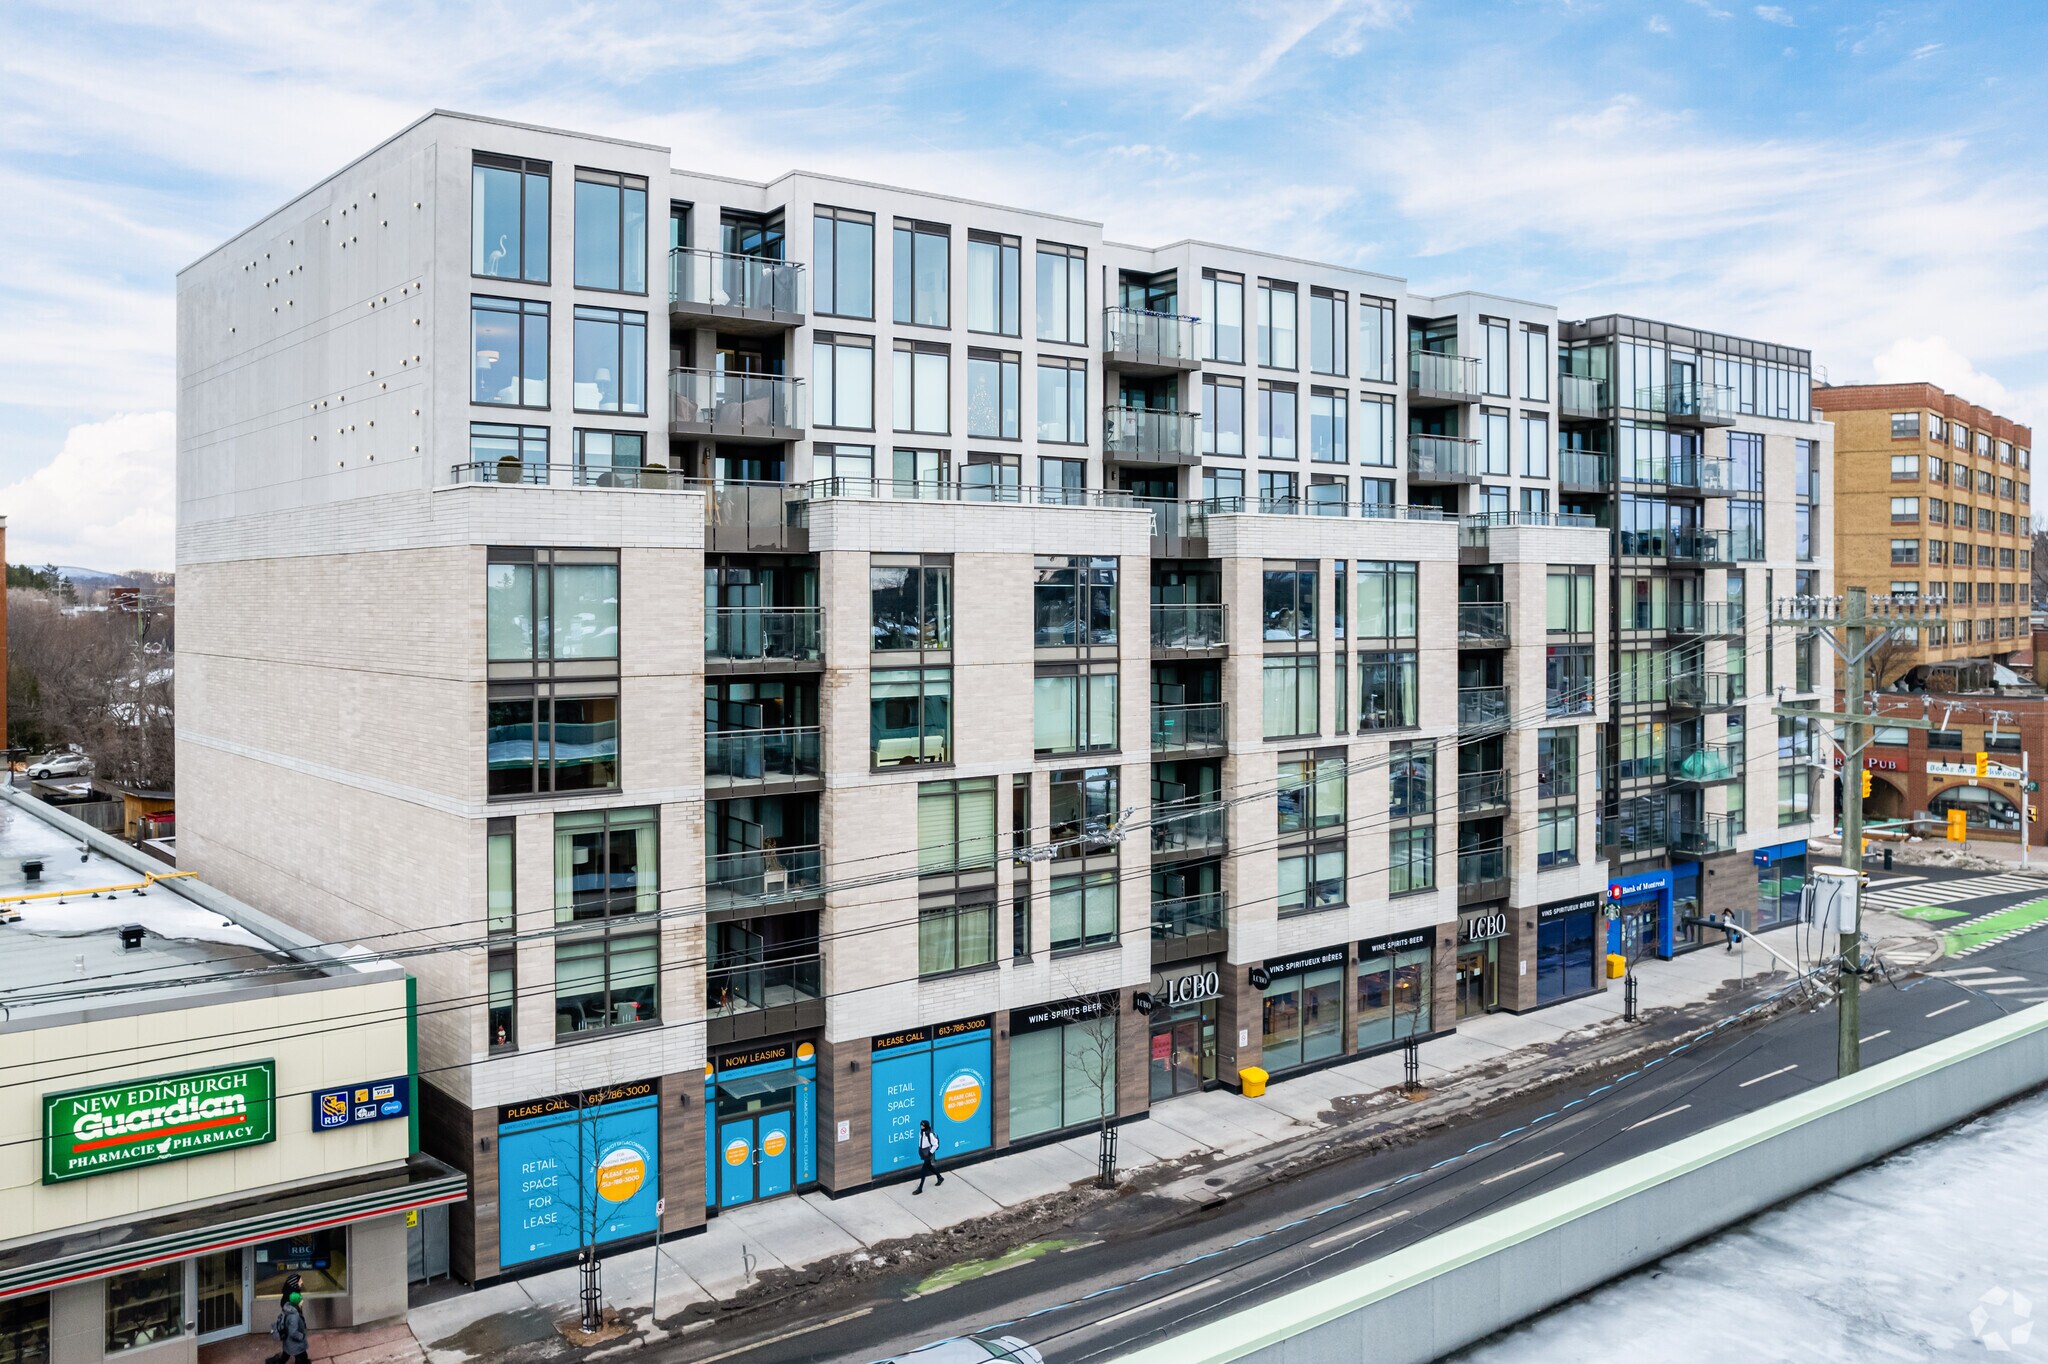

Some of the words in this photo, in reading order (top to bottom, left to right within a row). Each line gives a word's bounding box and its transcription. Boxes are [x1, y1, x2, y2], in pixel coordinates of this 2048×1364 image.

[1868, 758, 1896, 769] PUB
[1622, 885, 1636, 894] Bank
[1636, 883, 1643, 891] of
[1642, 878, 1665, 890] Montreal
[1469, 913, 1506, 940] LCBO
[1252, 974, 1268, 984] LCBO
[1168, 971, 1219, 1004] LCBO
[1136, 998, 1151, 1009] LCBO
[877, 1035, 904, 1048] PLEASE
[905, 1031, 925, 1042] CALL
[938, 1019, 986, 1036] 613-786-3000
[725, 1055, 748, 1067] NOW
[749, 1047, 786, 1063] LEASING
[72, 1093, 121, 1116] NEW
[127, 1073, 247, 1106] EDINBURGH
[887, 1082, 915, 1096] RETAIL
[508, 1104, 543, 1119] PLEASE
[545, 1099, 570, 1112] CALL
[588, 1084, 651, 1105] 613-786-3000
[887, 1097, 915, 1112] SPACE
[73, 1093, 247, 1141] Guardian
[324, 1114, 346, 1125] RBC
[892, 1114, 910, 1127] FOR
[888, 1129, 915, 1144] LEASE
[68, 1143, 155, 1169] PHARMACIE
[173, 1126, 254, 1149] PHARMACY
[522, 1158, 558, 1174] RETAIL
[602, 1169, 623, 1179] PLEASE
[623, 1166, 639, 1175] CALL
[522, 1175, 558, 1193] SPACE
[528, 1196, 552, 1209] FOR
[523, 1212, 558, 1230] LEASE
[291, 1246, 312, 1254] RBC
